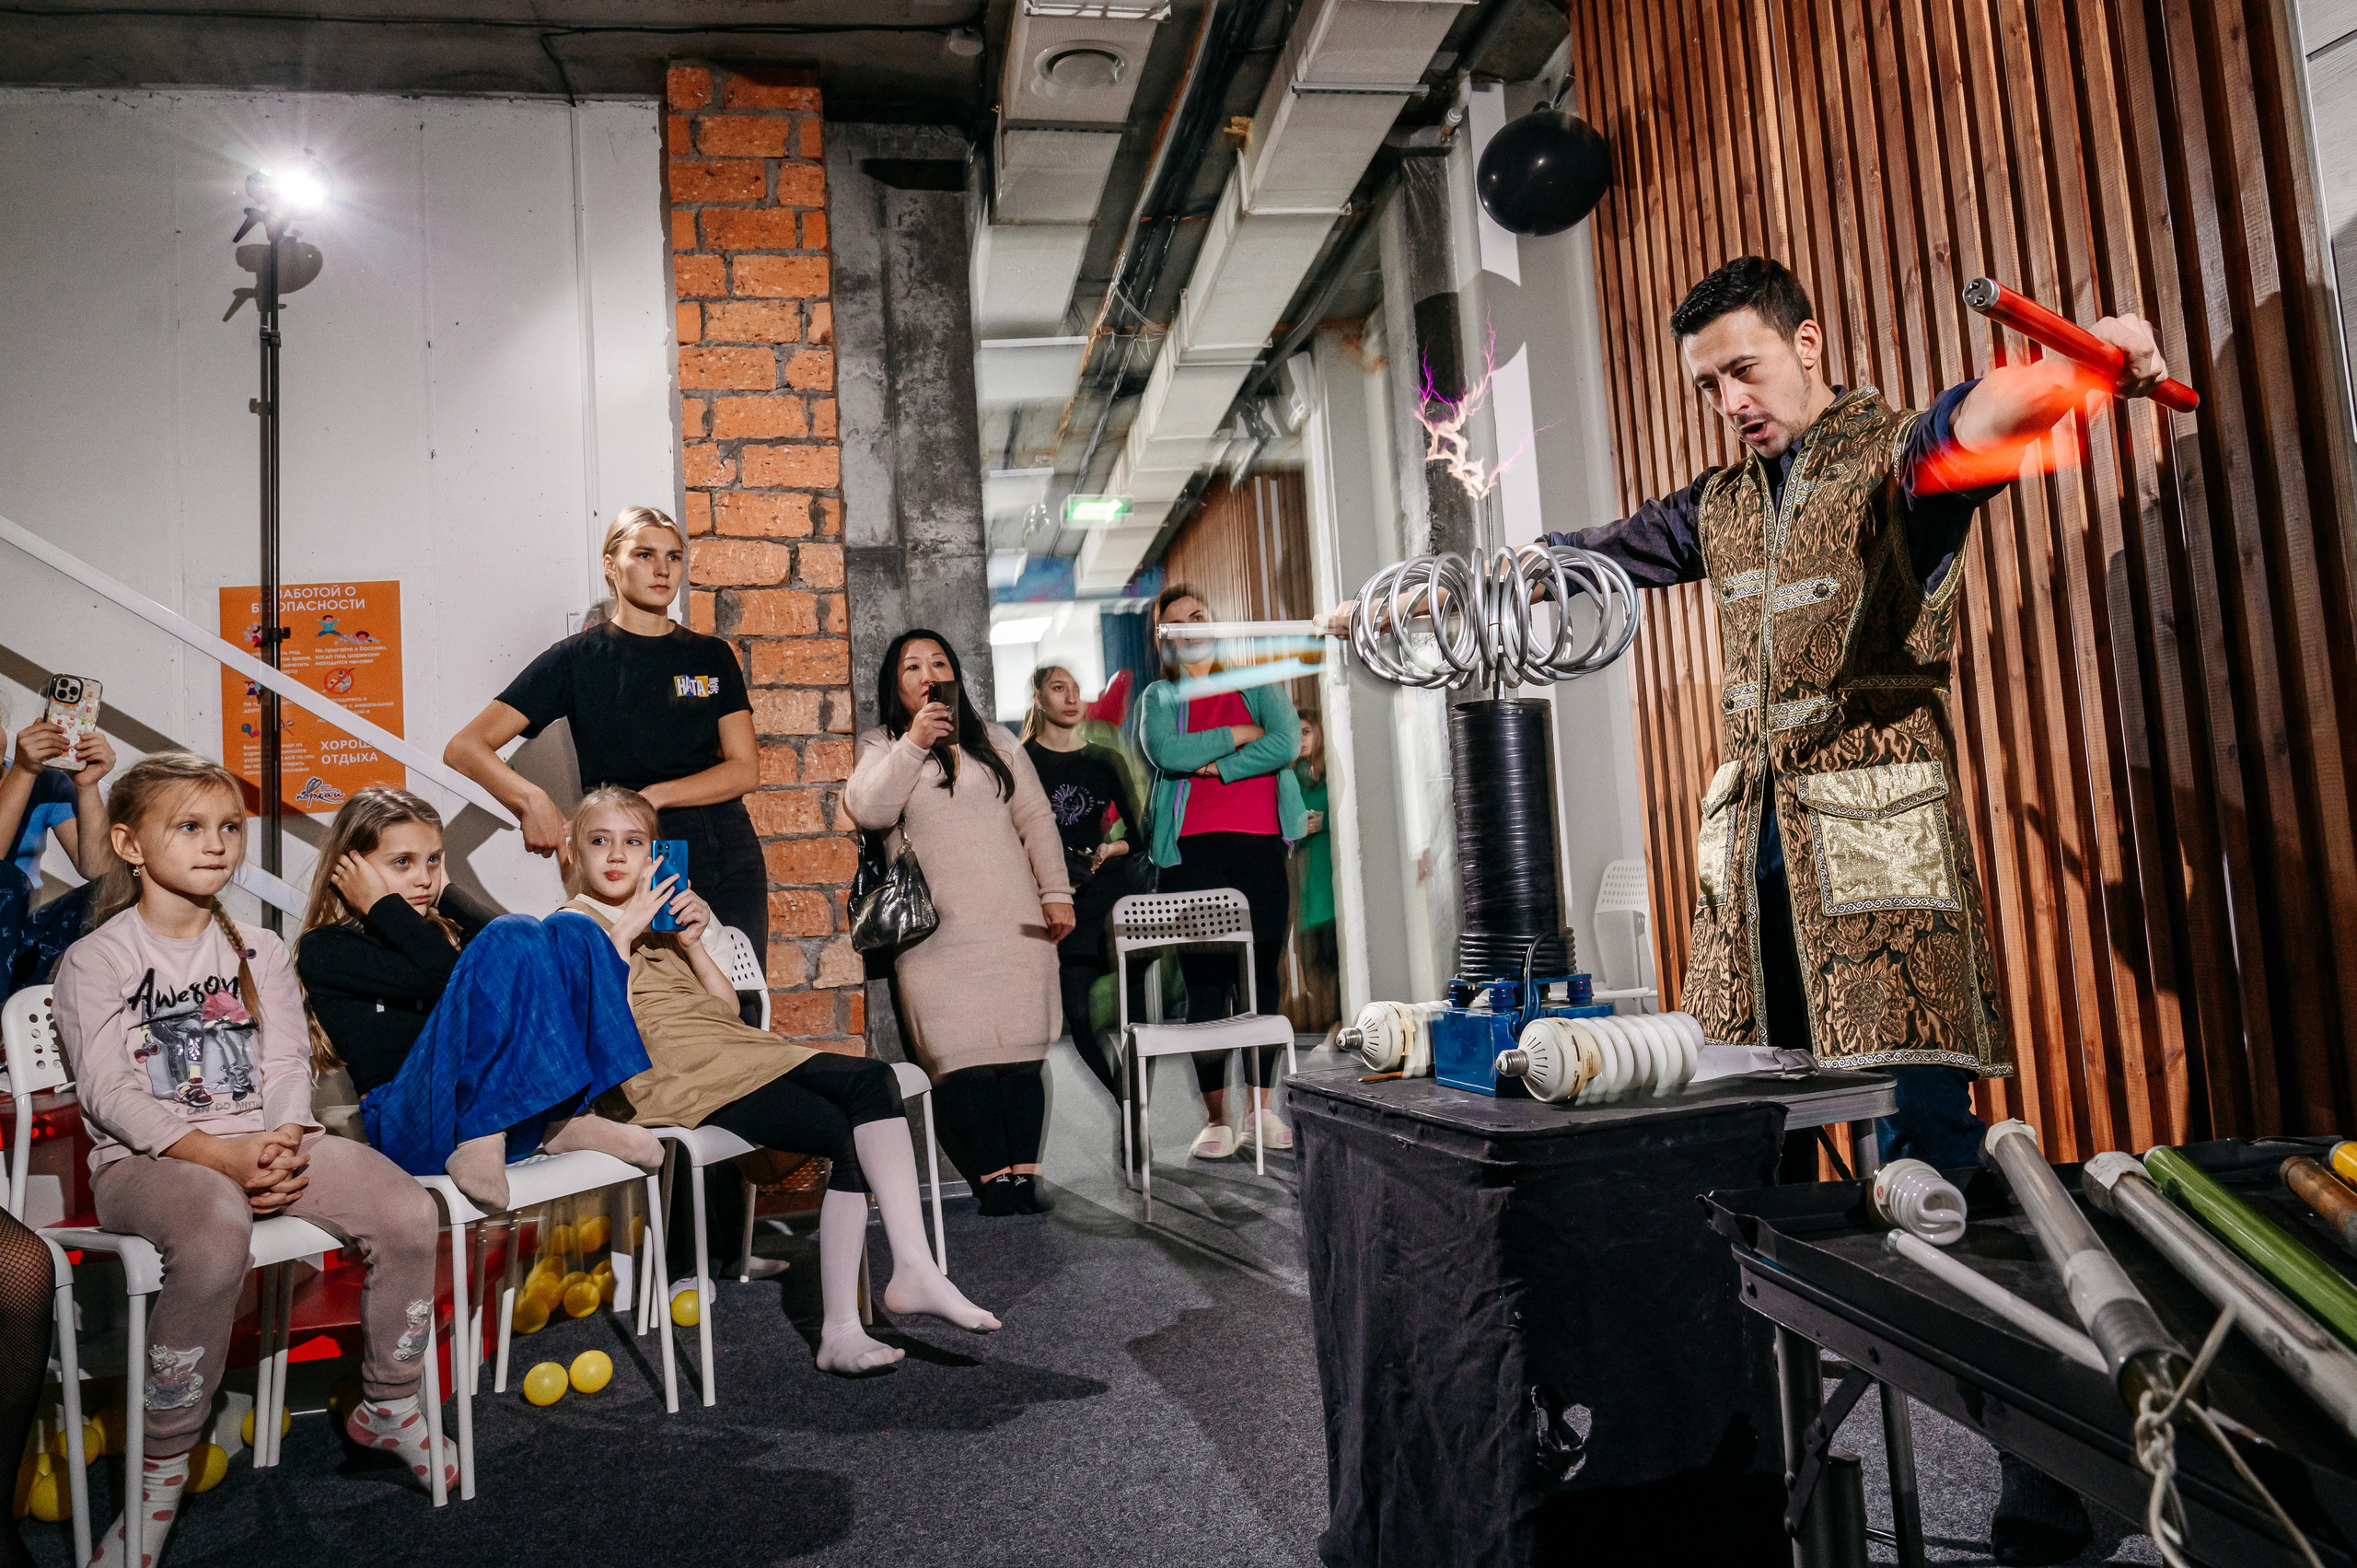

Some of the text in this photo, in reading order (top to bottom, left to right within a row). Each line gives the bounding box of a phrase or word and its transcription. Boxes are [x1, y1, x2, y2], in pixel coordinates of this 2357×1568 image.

[345, 587, 356, 597] О
[251, 598, 366, 613] БОПАСНОСТИ
[321, 751, 378, 766] ОТДЫХА
[187, 1106, 210, 1116] CAN
[215, 1102, 230, 1111] DO
